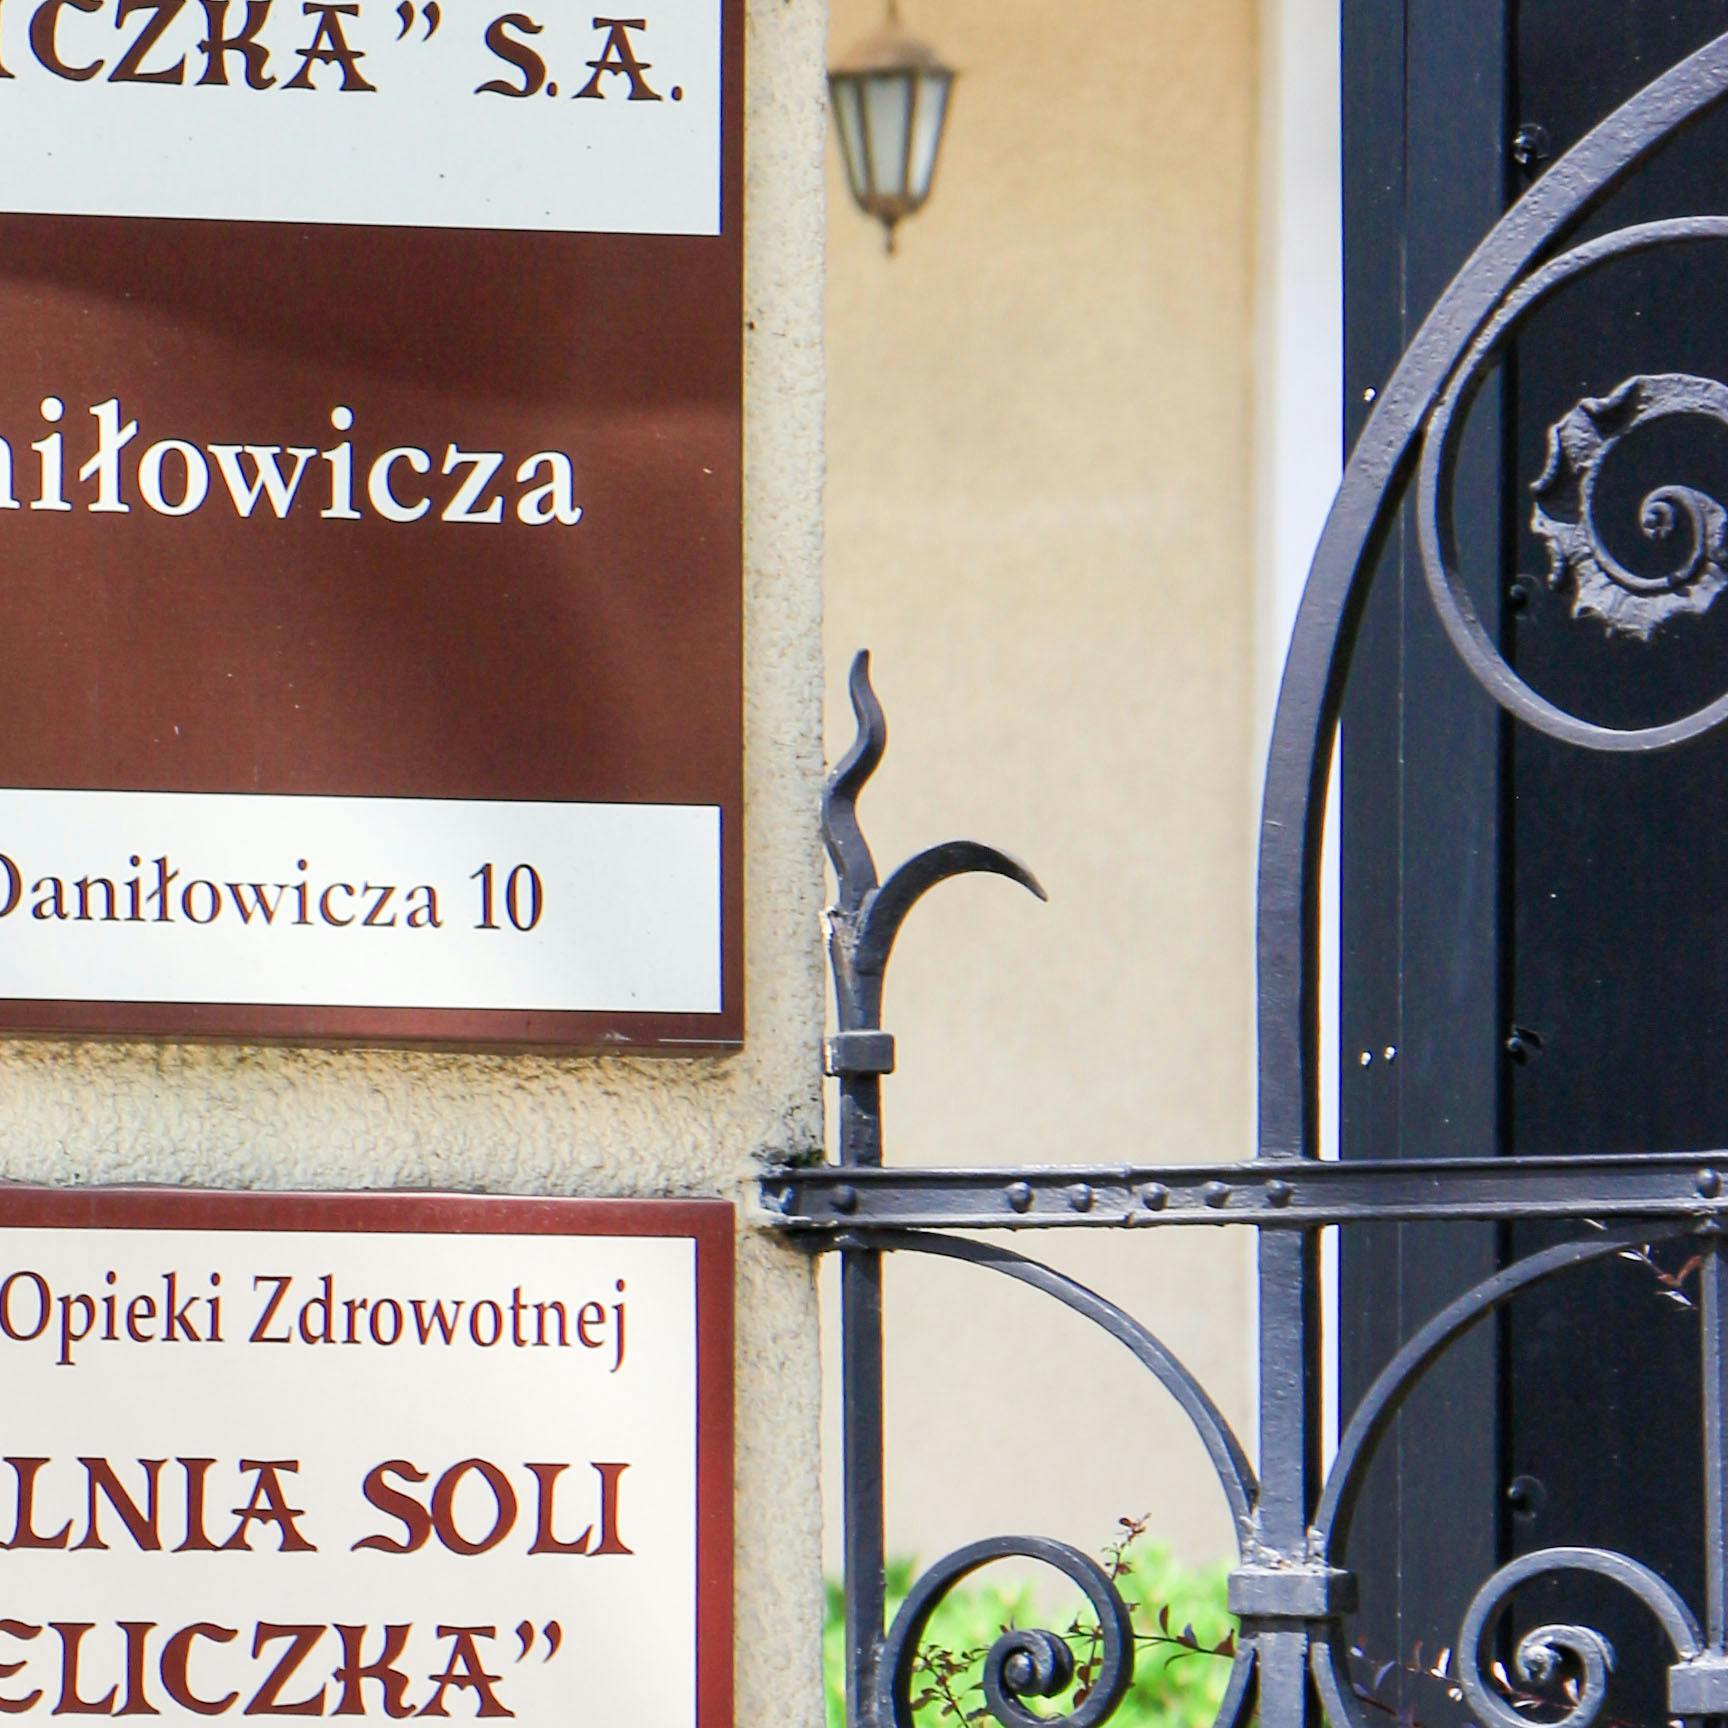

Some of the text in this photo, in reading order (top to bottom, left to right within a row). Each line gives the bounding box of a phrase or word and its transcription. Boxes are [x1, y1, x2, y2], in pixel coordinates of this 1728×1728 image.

[474, 13, 682, 101] S.A.
[470, 863, 542, 931] 10
[249, 1274, 625, 1373] Zdrowotnej
[350, 1458, 634, 1557] SOLI
